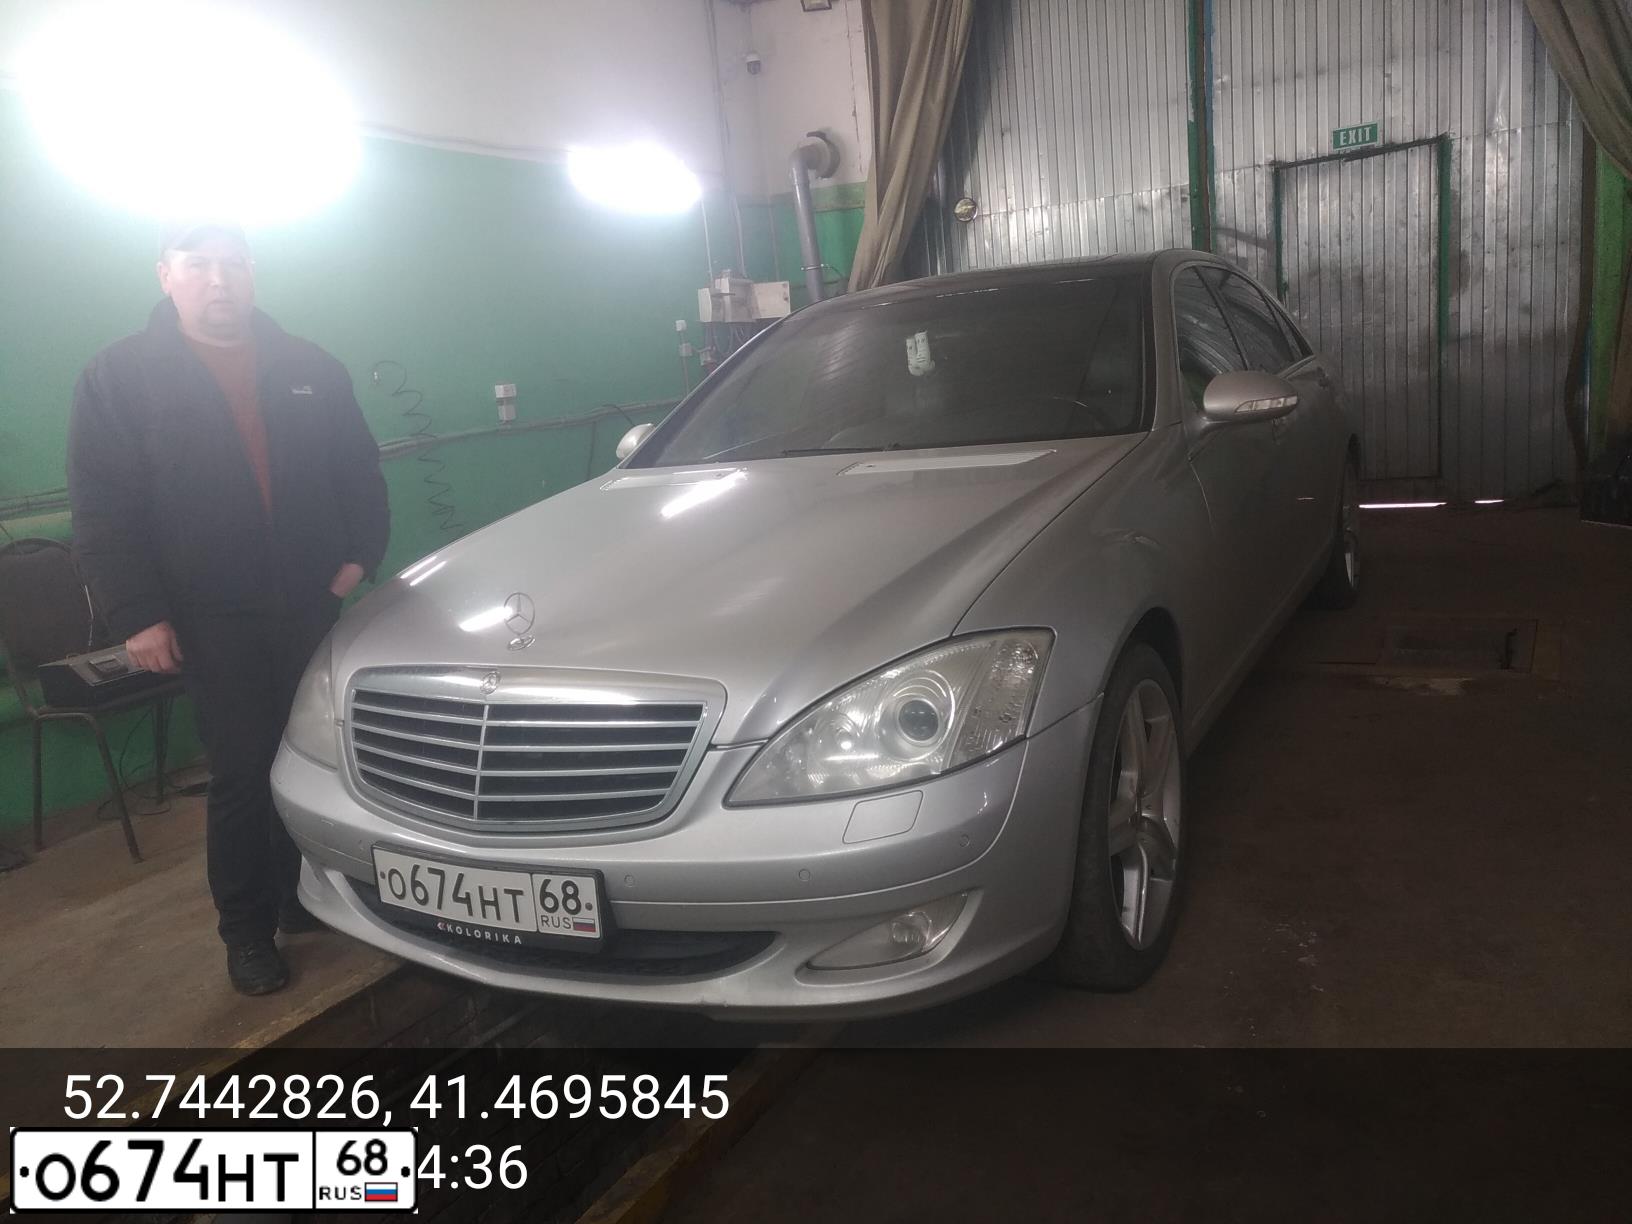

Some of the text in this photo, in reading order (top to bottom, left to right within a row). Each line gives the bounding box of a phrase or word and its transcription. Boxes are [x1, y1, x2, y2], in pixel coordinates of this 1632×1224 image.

[1340, 127, 1371, 145] EXIT
[539, 878, 581, 915] 68
[540, 914, 572, 930] RUS
